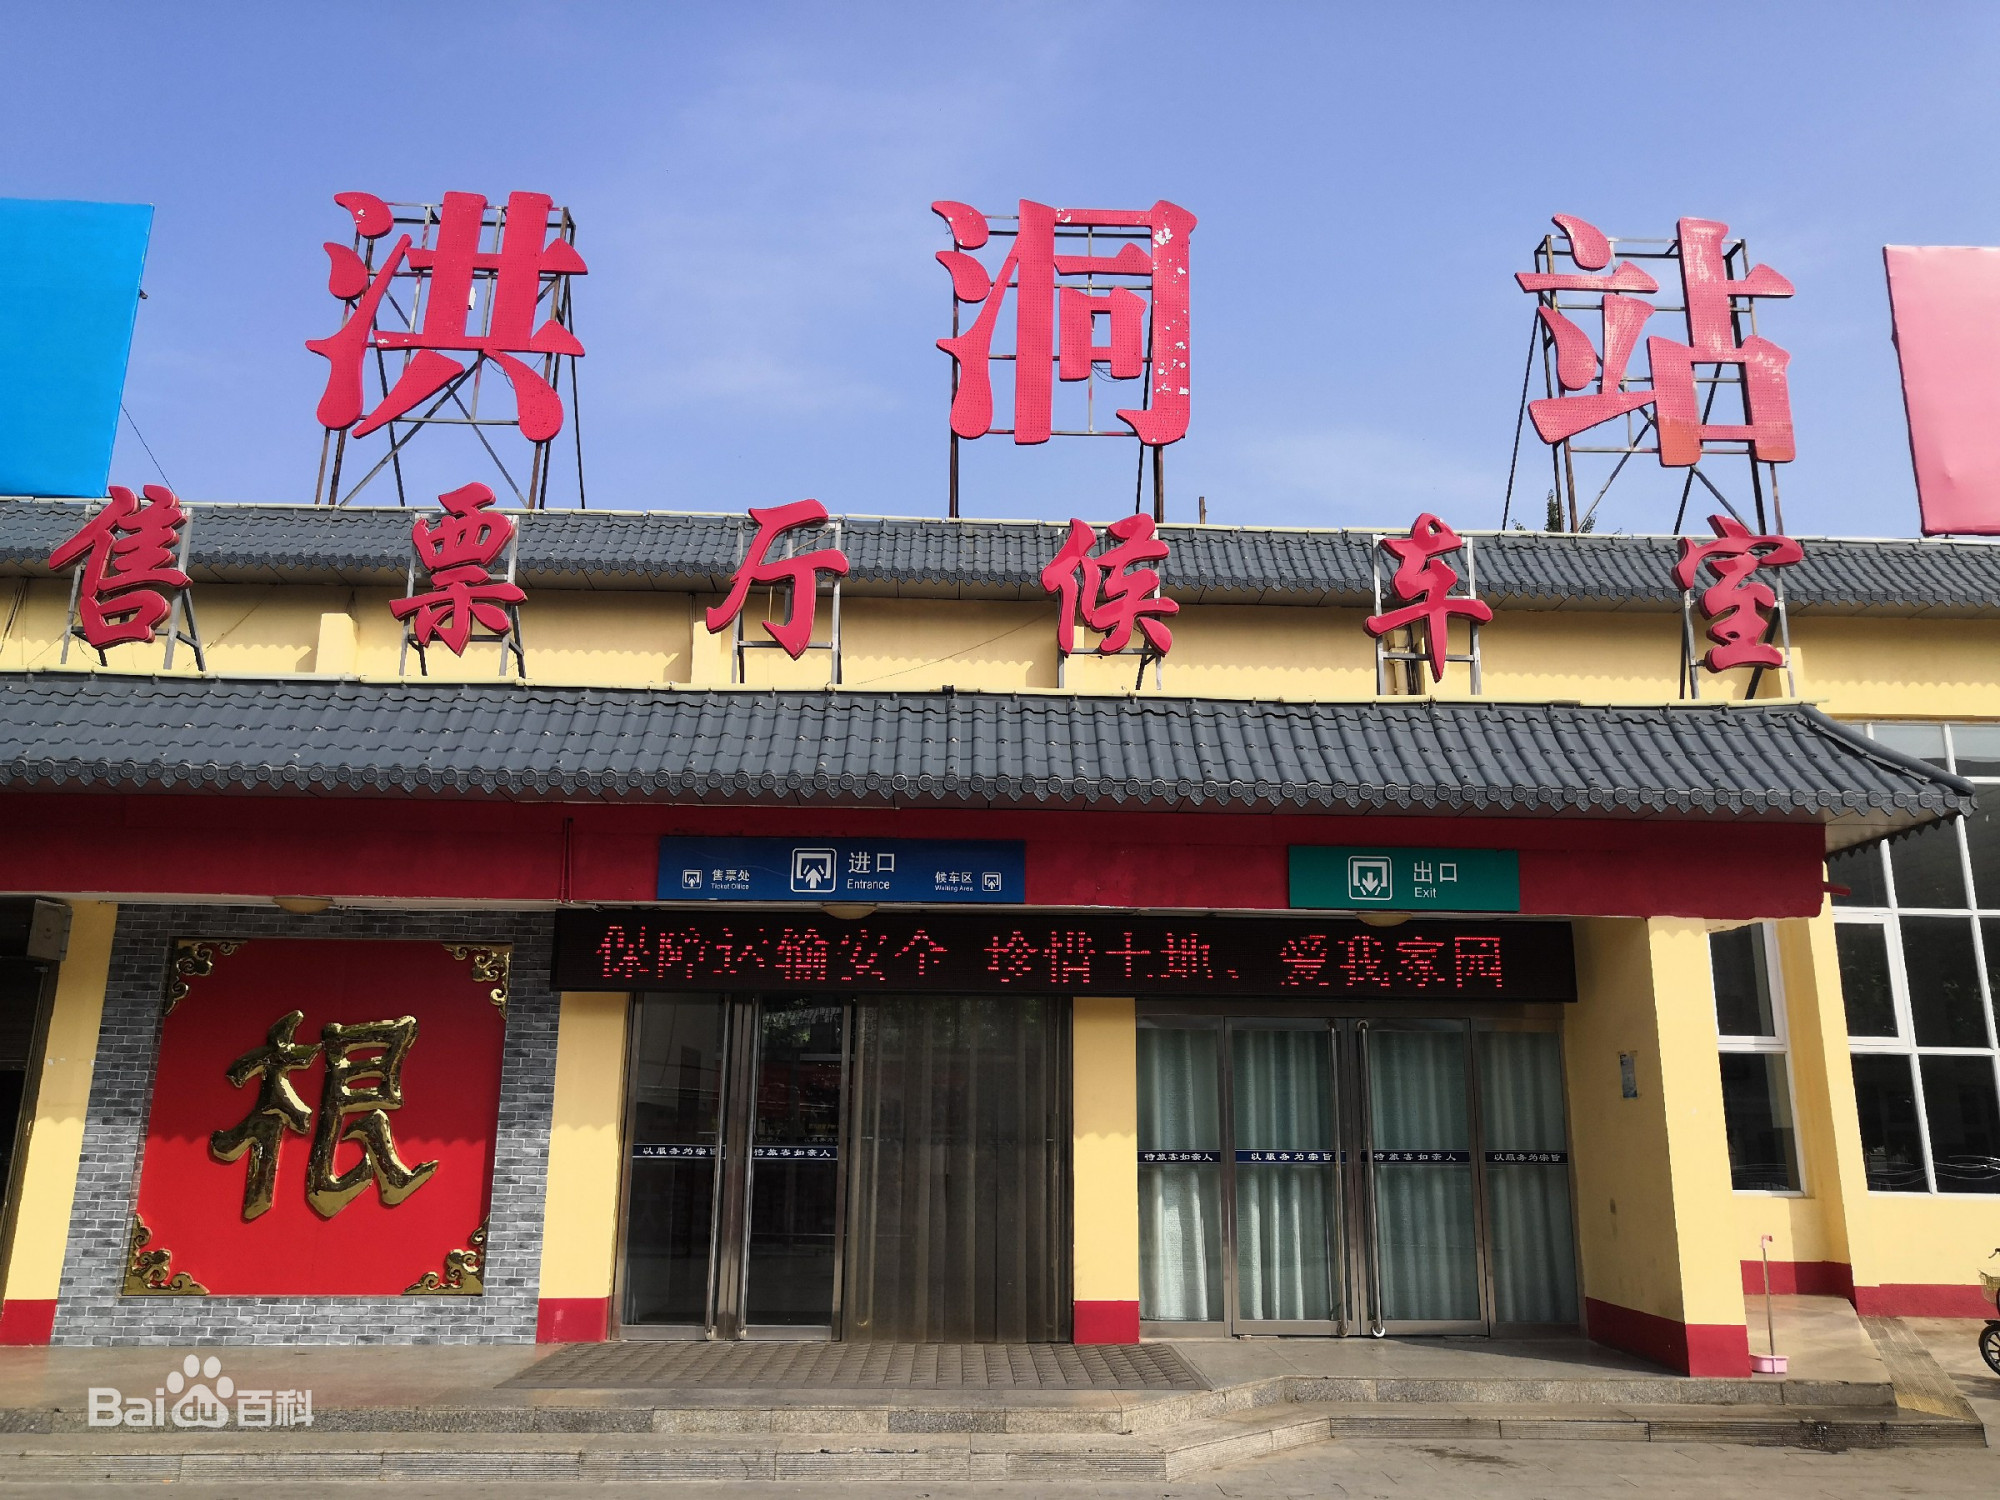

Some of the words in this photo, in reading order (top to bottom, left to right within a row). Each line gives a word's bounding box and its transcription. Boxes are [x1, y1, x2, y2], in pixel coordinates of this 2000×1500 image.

[848, 851, 895, 874] 进口
[711, 868, 750, 882] 售票处
[934, 871, 973, 884] 候车区
[1413, 860, 1458, 884] 出口
[710, 882, 731, 890] Ticket
[731, 882, 750, 890] Office
[847, 878, 891, 890] Entrance
[934, 884, 959, 893] Waiting
[1414, 886, 1437, 898] Exit
[209, 1009, 440, 1220] 根
[1144, 1152, 1214, 1162] 待旅客如亲人
[1250, 1152, 1333, 1161] 以服务为宗旨
[1373, 1152, 1457, 1162] 待旅客如亲人
[1494, 1153, 1560, 1162] 以服务为宗旨
